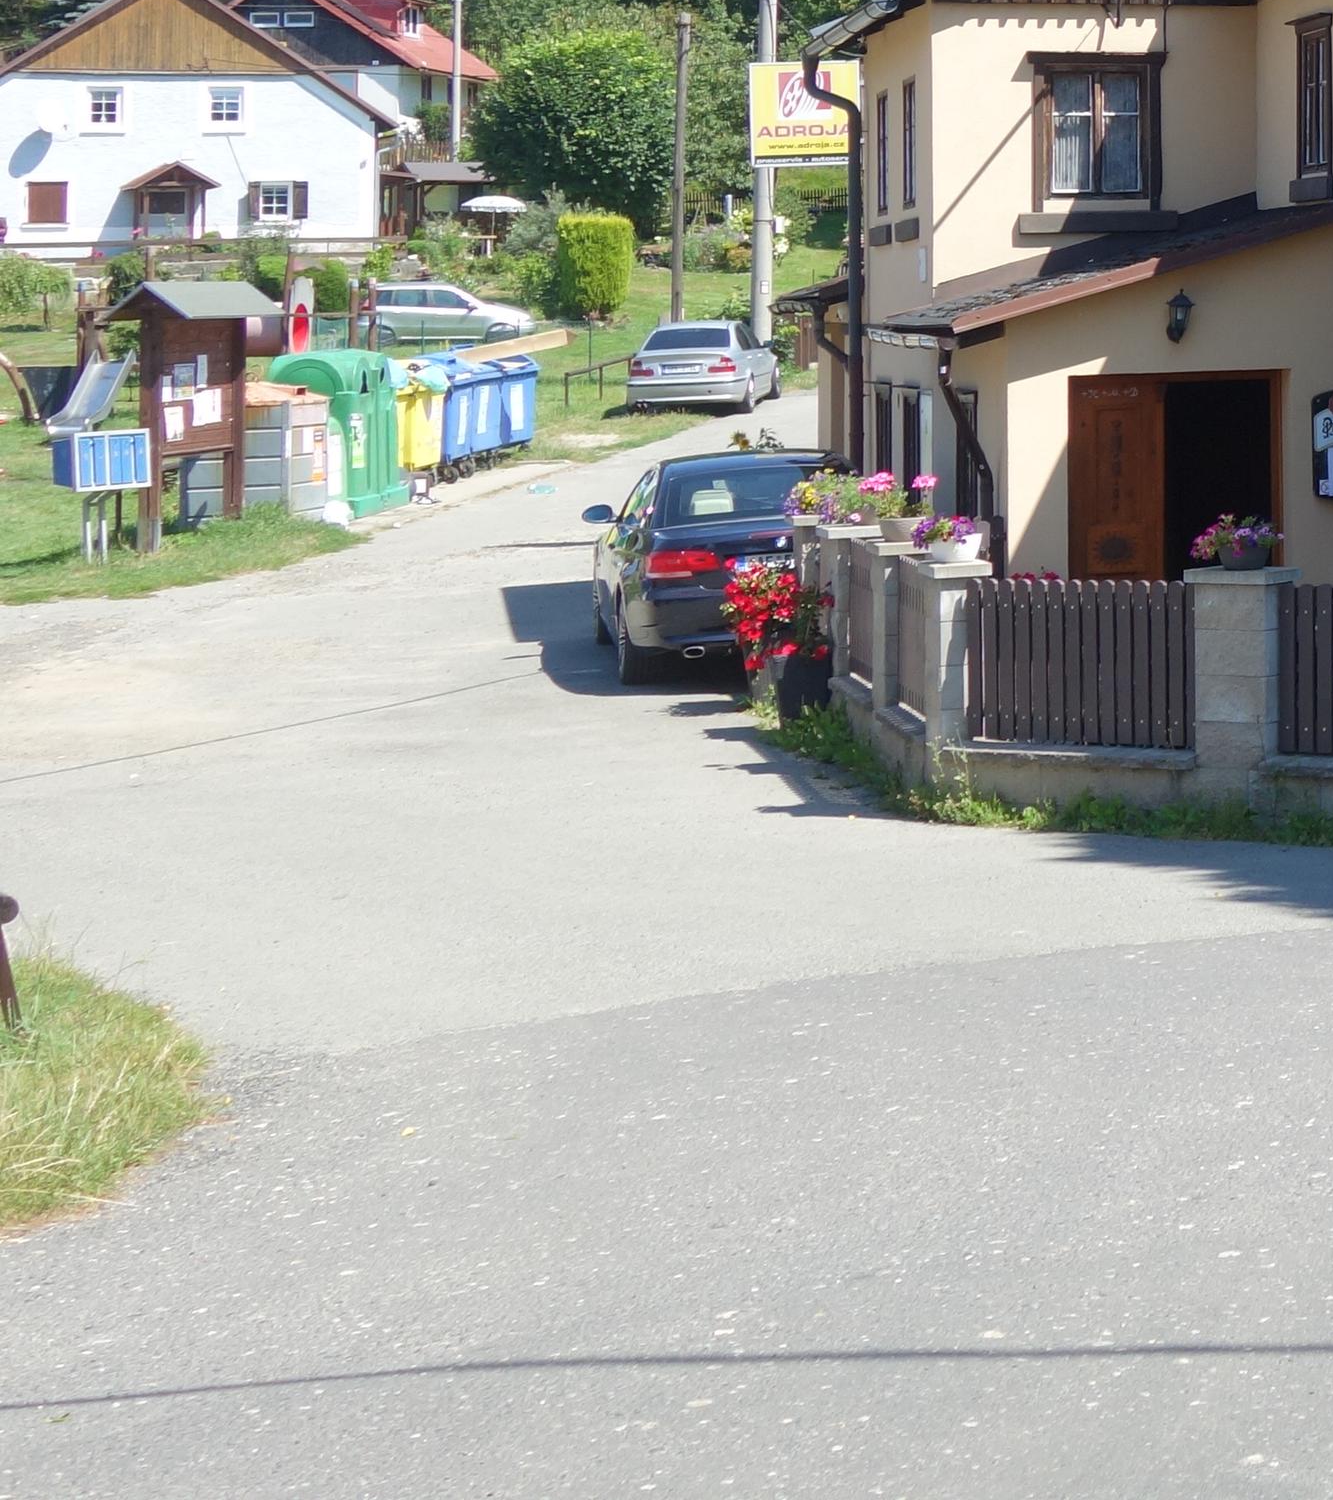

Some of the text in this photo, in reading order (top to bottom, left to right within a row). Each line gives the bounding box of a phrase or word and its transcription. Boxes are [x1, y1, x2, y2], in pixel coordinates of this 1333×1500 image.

[757, 124, 849, 138] ADROJA
[768, 141, 845, 150] www.adroja.cz
[811, 155, 849, 163] autoserv
